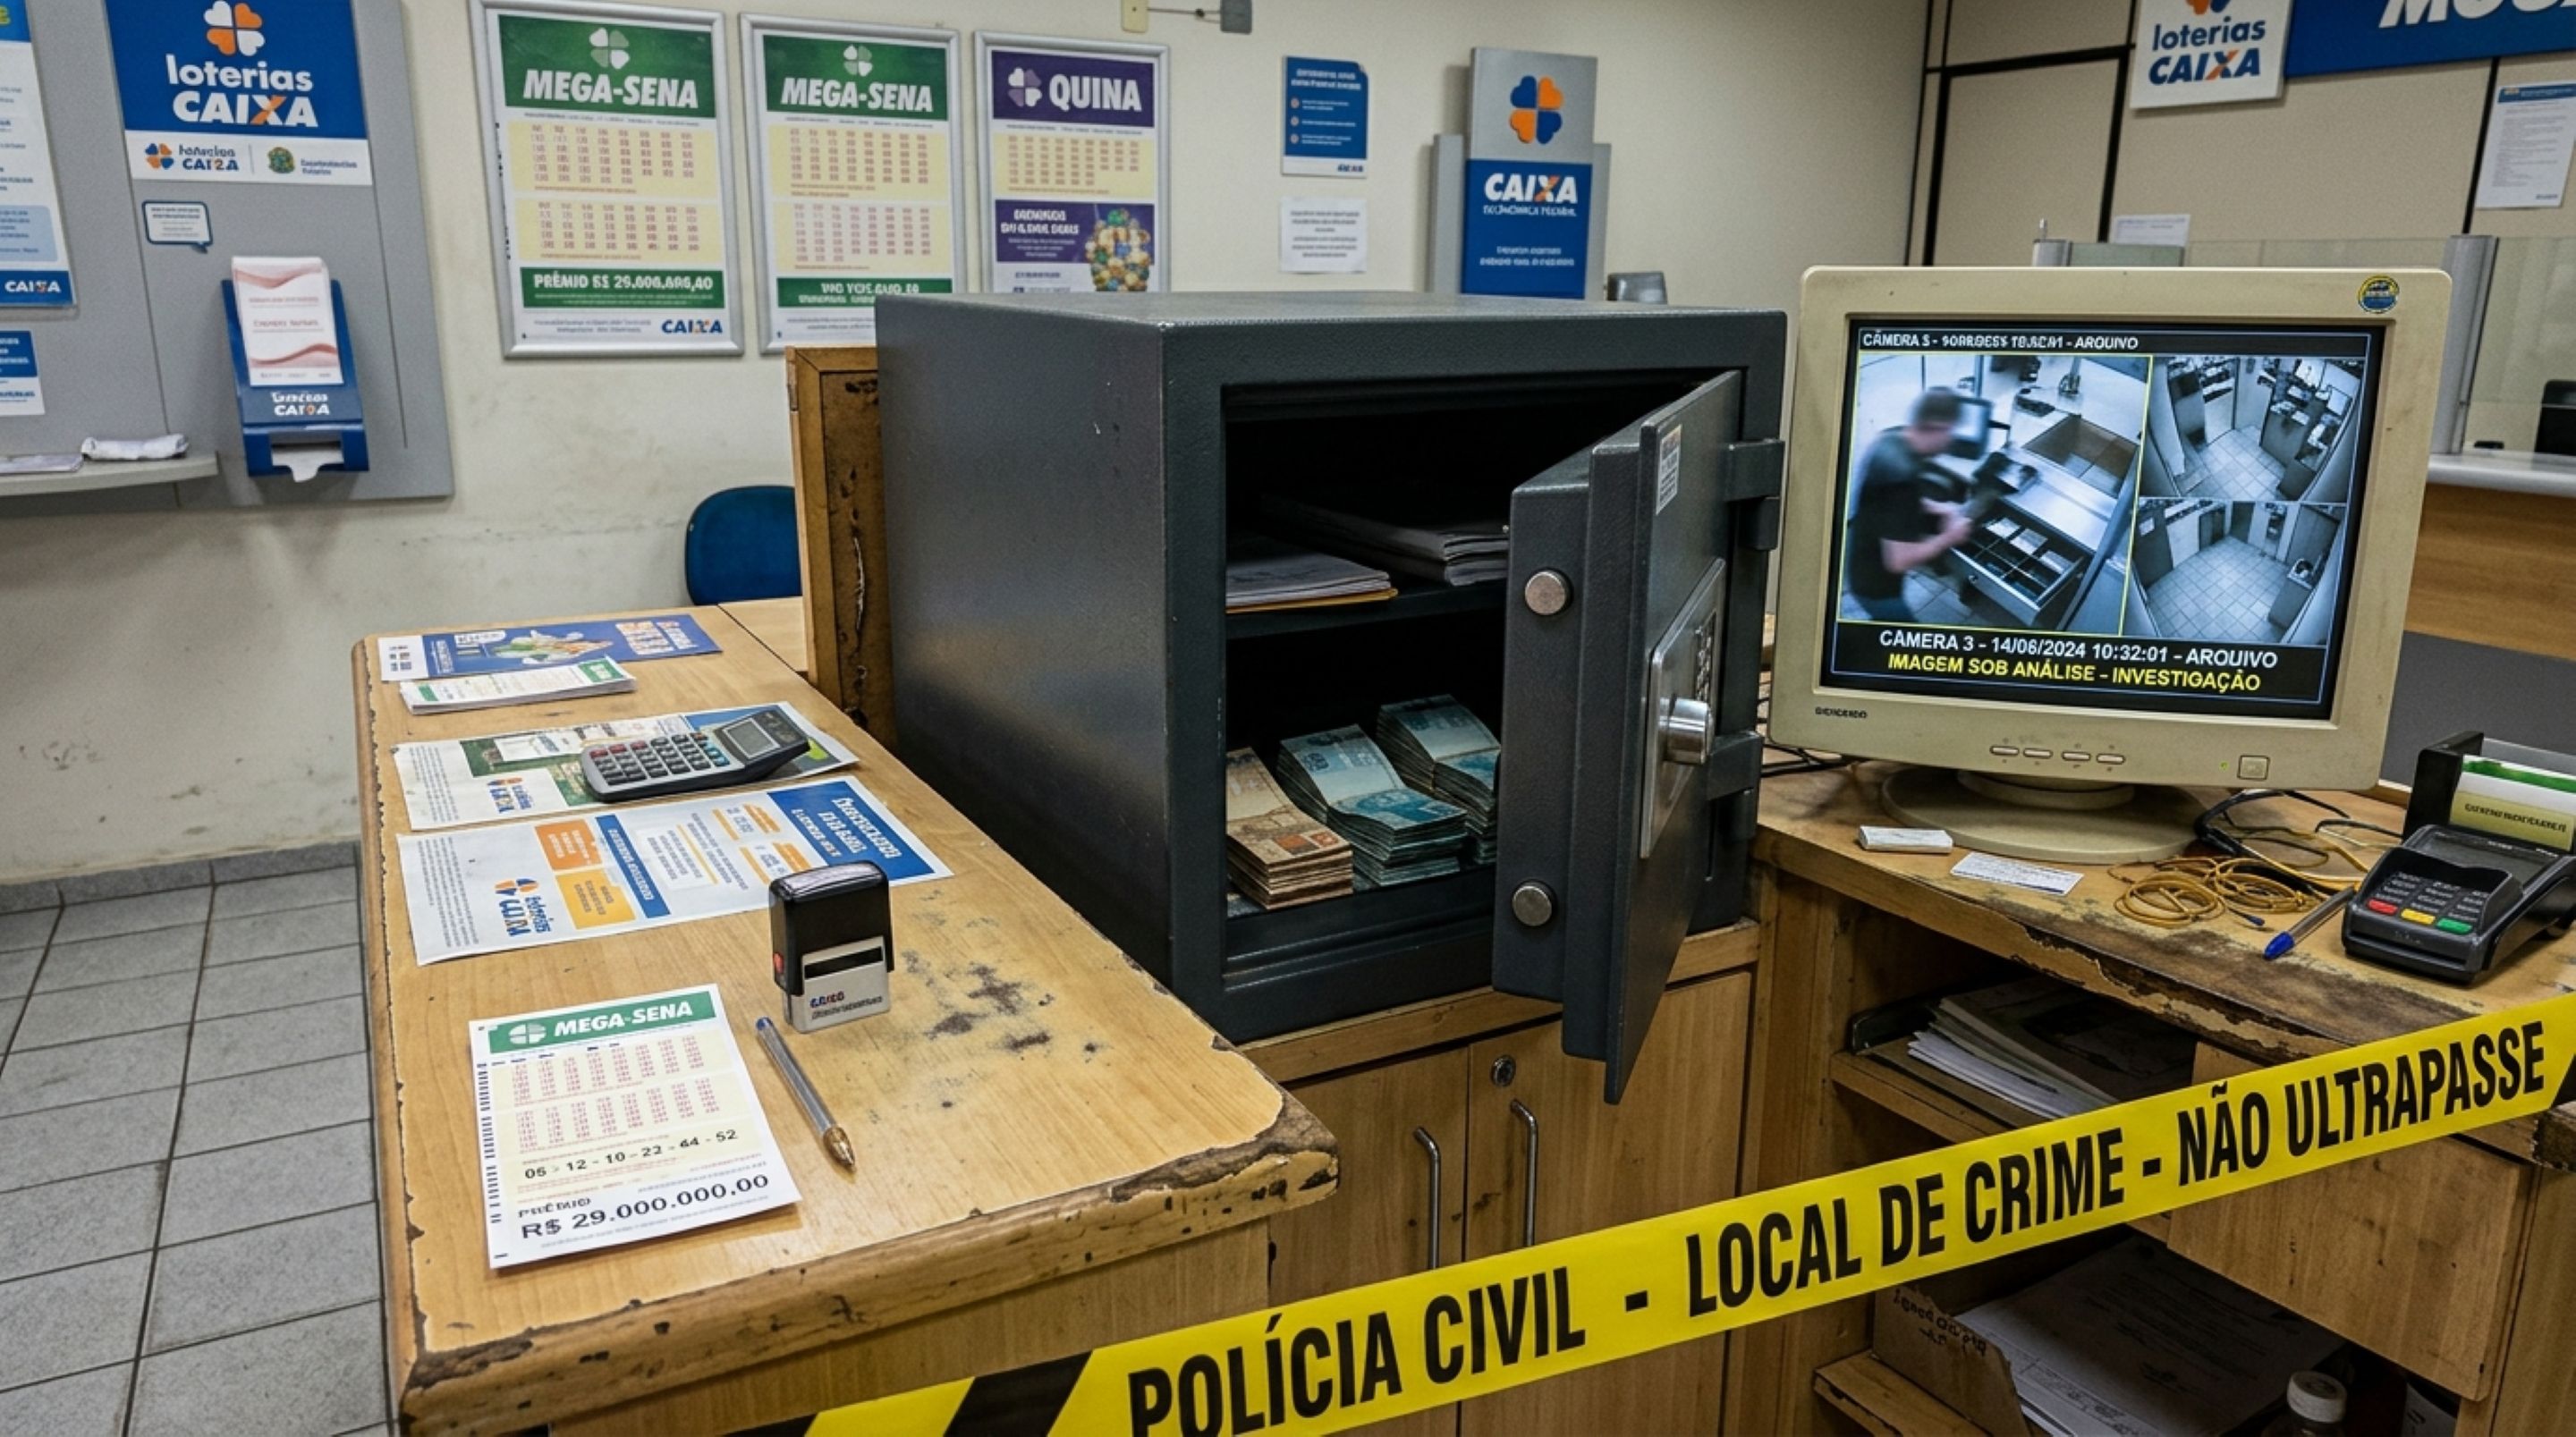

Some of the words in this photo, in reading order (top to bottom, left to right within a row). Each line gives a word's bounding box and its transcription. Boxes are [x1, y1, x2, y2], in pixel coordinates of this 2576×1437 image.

[2152, 16, 2266, 51] loterias
[165, 54, 313, 91] loterias
[2148, 47, 2260, 85] CAIXA
[523, 69, 698, 108] MEGA-SENA
[781, 77, 933, 112] MEGA-SENA
[1049, 74, 1142, 112] QUINA
[173, 90, 318, 127] CAIXA
[1485, 173, 1578, 204] CAIXA
[1880, 630, 1958, 651] CÂMERA
[1963, 635, 1974, 651] 3
[1991, 637, 2086, 658] 14/06/2024
[2092, 643, 2167, 663] 10:32:01
[1888, 654, 1963, 673] IMAGEM
[1968, 659, 2008, 676] SOB
[2012, 658, 2096, 680] ANÁLISE
[2113, 666, 2261, 693] INVESTIGAÇÃO
[555, 1001, 693, 1036] MEGA-SENA
[566, 1160, 587, 1171] 12
[606, 1152, 625, 1163] 10
[716, 1128, 739, 1142] 52
[521, 1219, 562, 1238] R$
[572, 1173, 768, 1230] 29.000.000.00
[1128, 1314, 1402, 1437] POLÍCIA
[1424, 1266, 1586, 1385] CIVIL
[1625, 1289, 1648, 1312] -
[1686, 1197, 1861, 1317] LOCAL
[1879, 1173, 1945, 1267] DE
[1965, 1127, 2124, 1243] CRIME
[2142, 1157, 2161, 1177] -
[2178, 1080, 2270, 1186] NÃO
[2285, 1020, 2545, 1156] ULTRAPASSE
